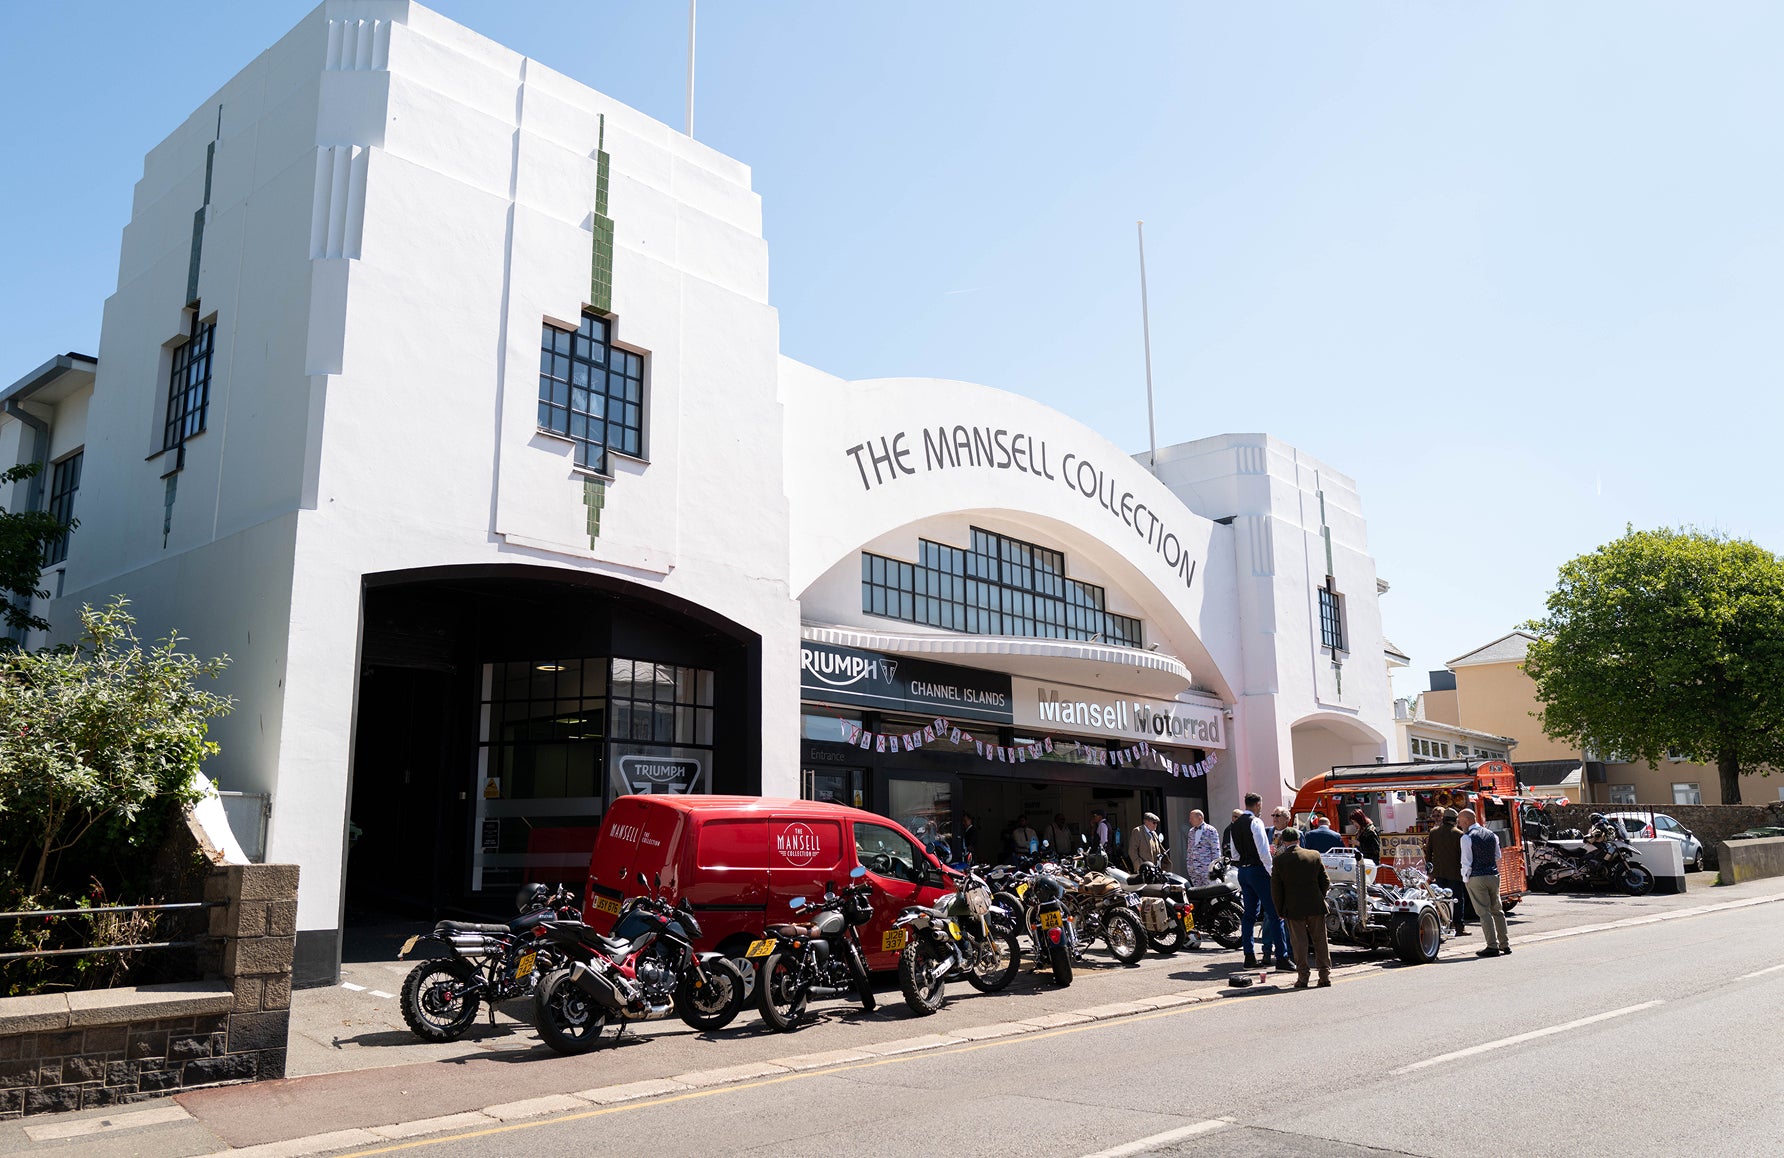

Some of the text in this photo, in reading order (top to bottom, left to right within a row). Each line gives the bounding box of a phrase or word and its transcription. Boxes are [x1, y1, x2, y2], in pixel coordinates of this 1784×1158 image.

[846, 425, 1196, 588] THE MANSELL COLLECTION
[801, 648, 1006, 707] RIUMPH CHANNEL ISLANDS
[1038, 687, 1221, 743] Mansell Motorrad
[810, 747, 846, 761] Entrance
[634, 764, 686, 780] TRIUMPH
[609, 823, 639, 843] MANSELL
[777, 834, 821, 851] MANSELL
[885, 930, 904, 940] J128
[885, 938, 903, 949] 337
